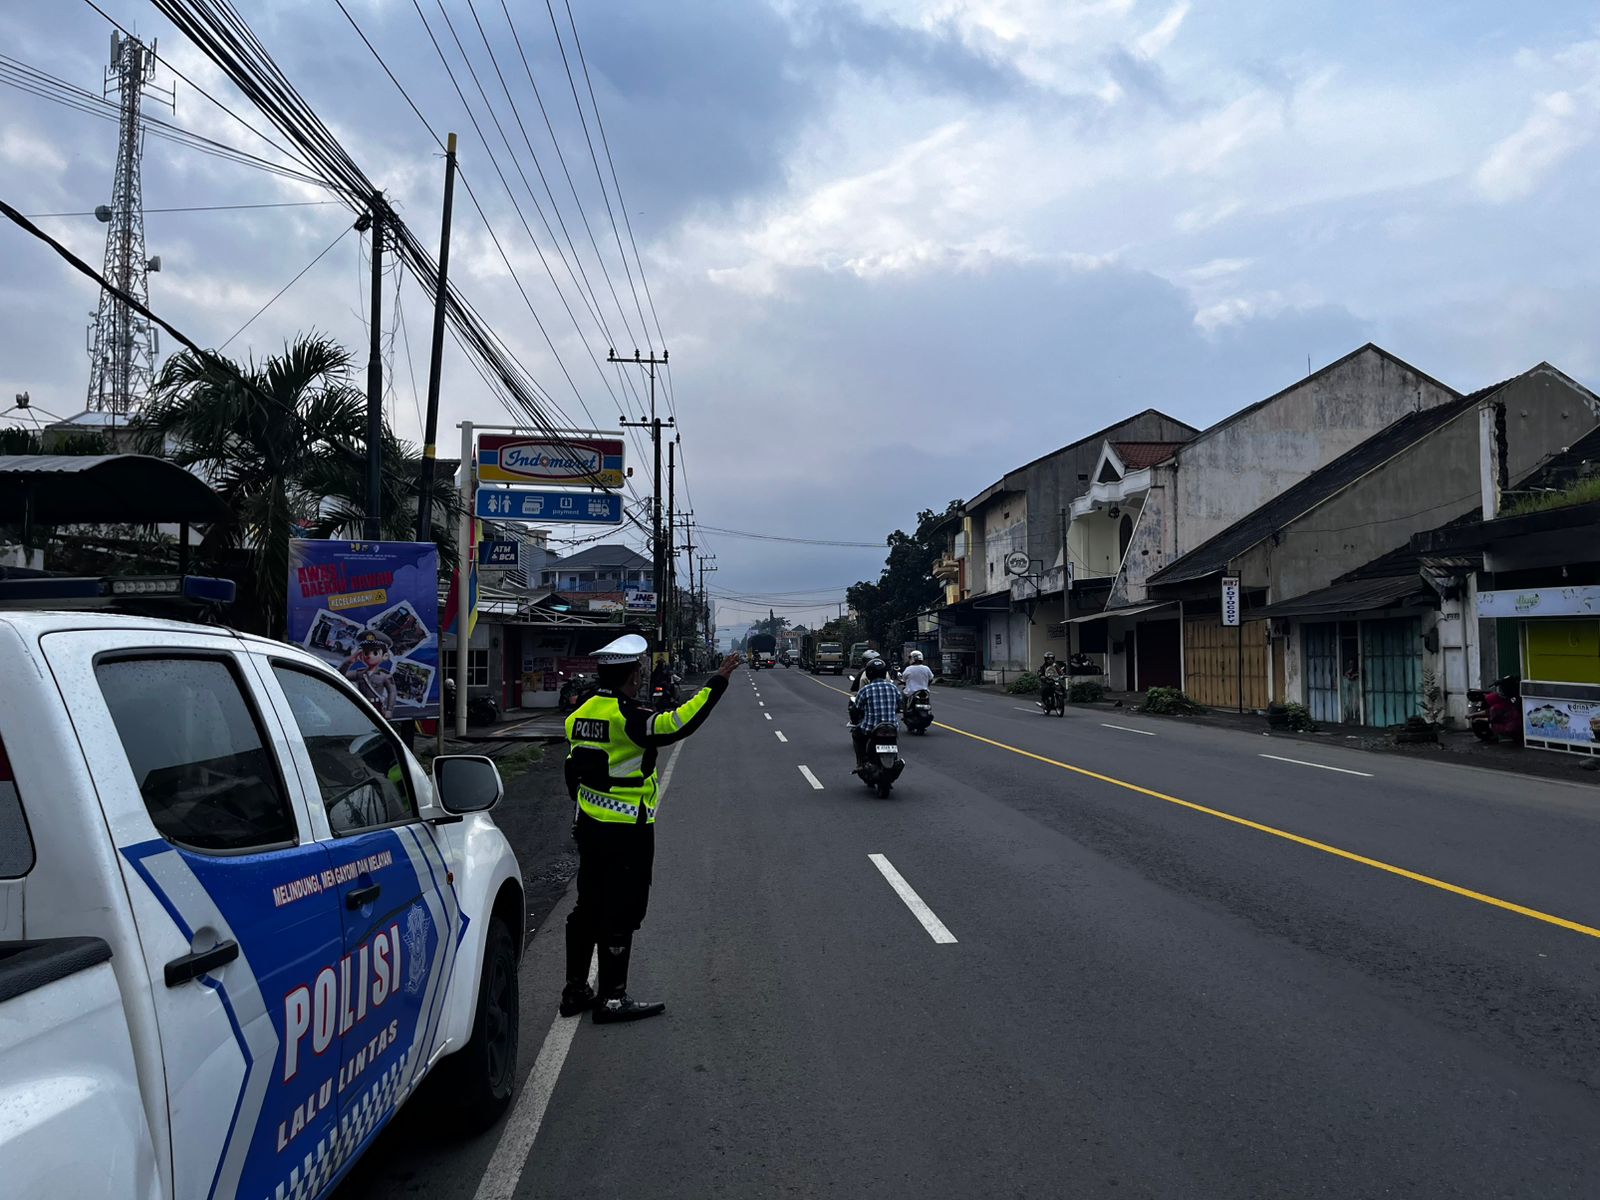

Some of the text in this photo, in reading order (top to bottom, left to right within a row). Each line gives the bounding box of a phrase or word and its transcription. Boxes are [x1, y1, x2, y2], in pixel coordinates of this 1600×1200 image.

[494, 545, 511, 553] ATM
[1227, 587, 1235, 623] FOTOCOPY
[575, 720, 603, 739] POLISI
[272, 874, 323, 908] MELINDUNGI,
[356, 857, 370, 876] DAN
[367, 850, 393, 872] MELAYANI
[284, 922, 402, 1083] POLISI
[277, 1018, 399, 1152] LALU LINTAS
